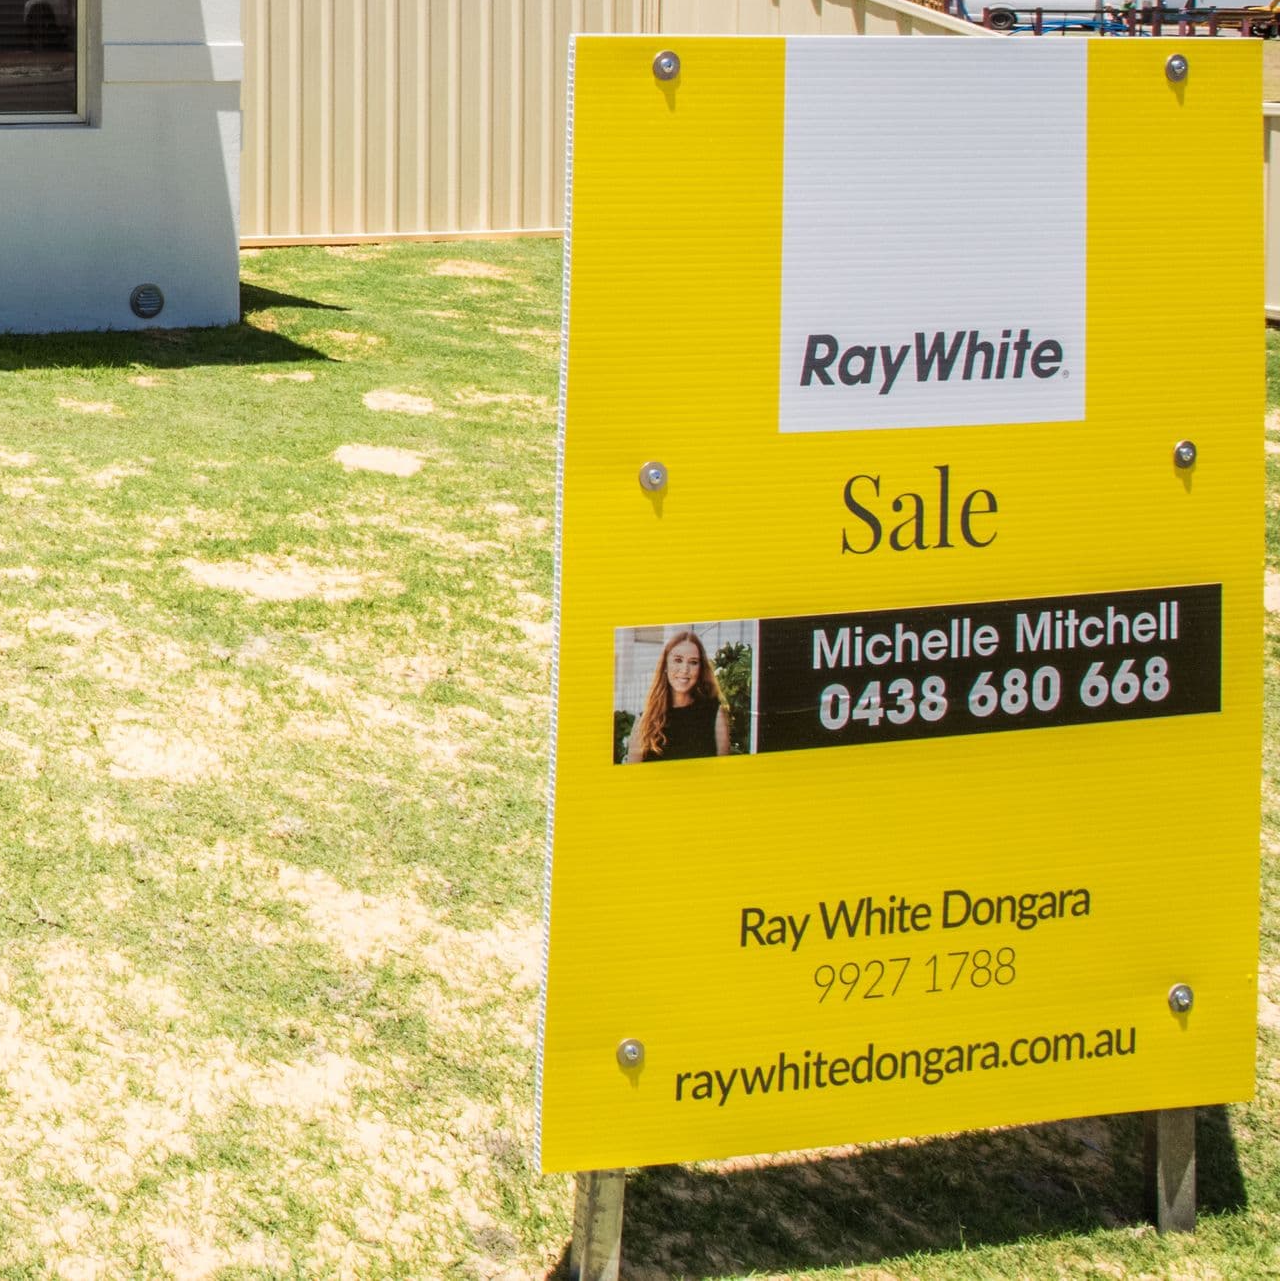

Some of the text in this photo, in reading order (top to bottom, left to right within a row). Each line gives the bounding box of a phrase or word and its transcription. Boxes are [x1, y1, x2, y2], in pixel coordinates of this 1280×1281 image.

[799, 328, 1063, 396] RayWhite
[841, 464, 999, 555] Sale
[812, 600, 1179, 670] Michelle Mitchell
[819, 656, 1171, 730] 0438 680 668
[740, 888, 1091, 952] Ray White Dongara
[814, 946, 1016, 1004] 9927 1788
[675, 1026, 1137, 1107] raywhitedongara.com.au
